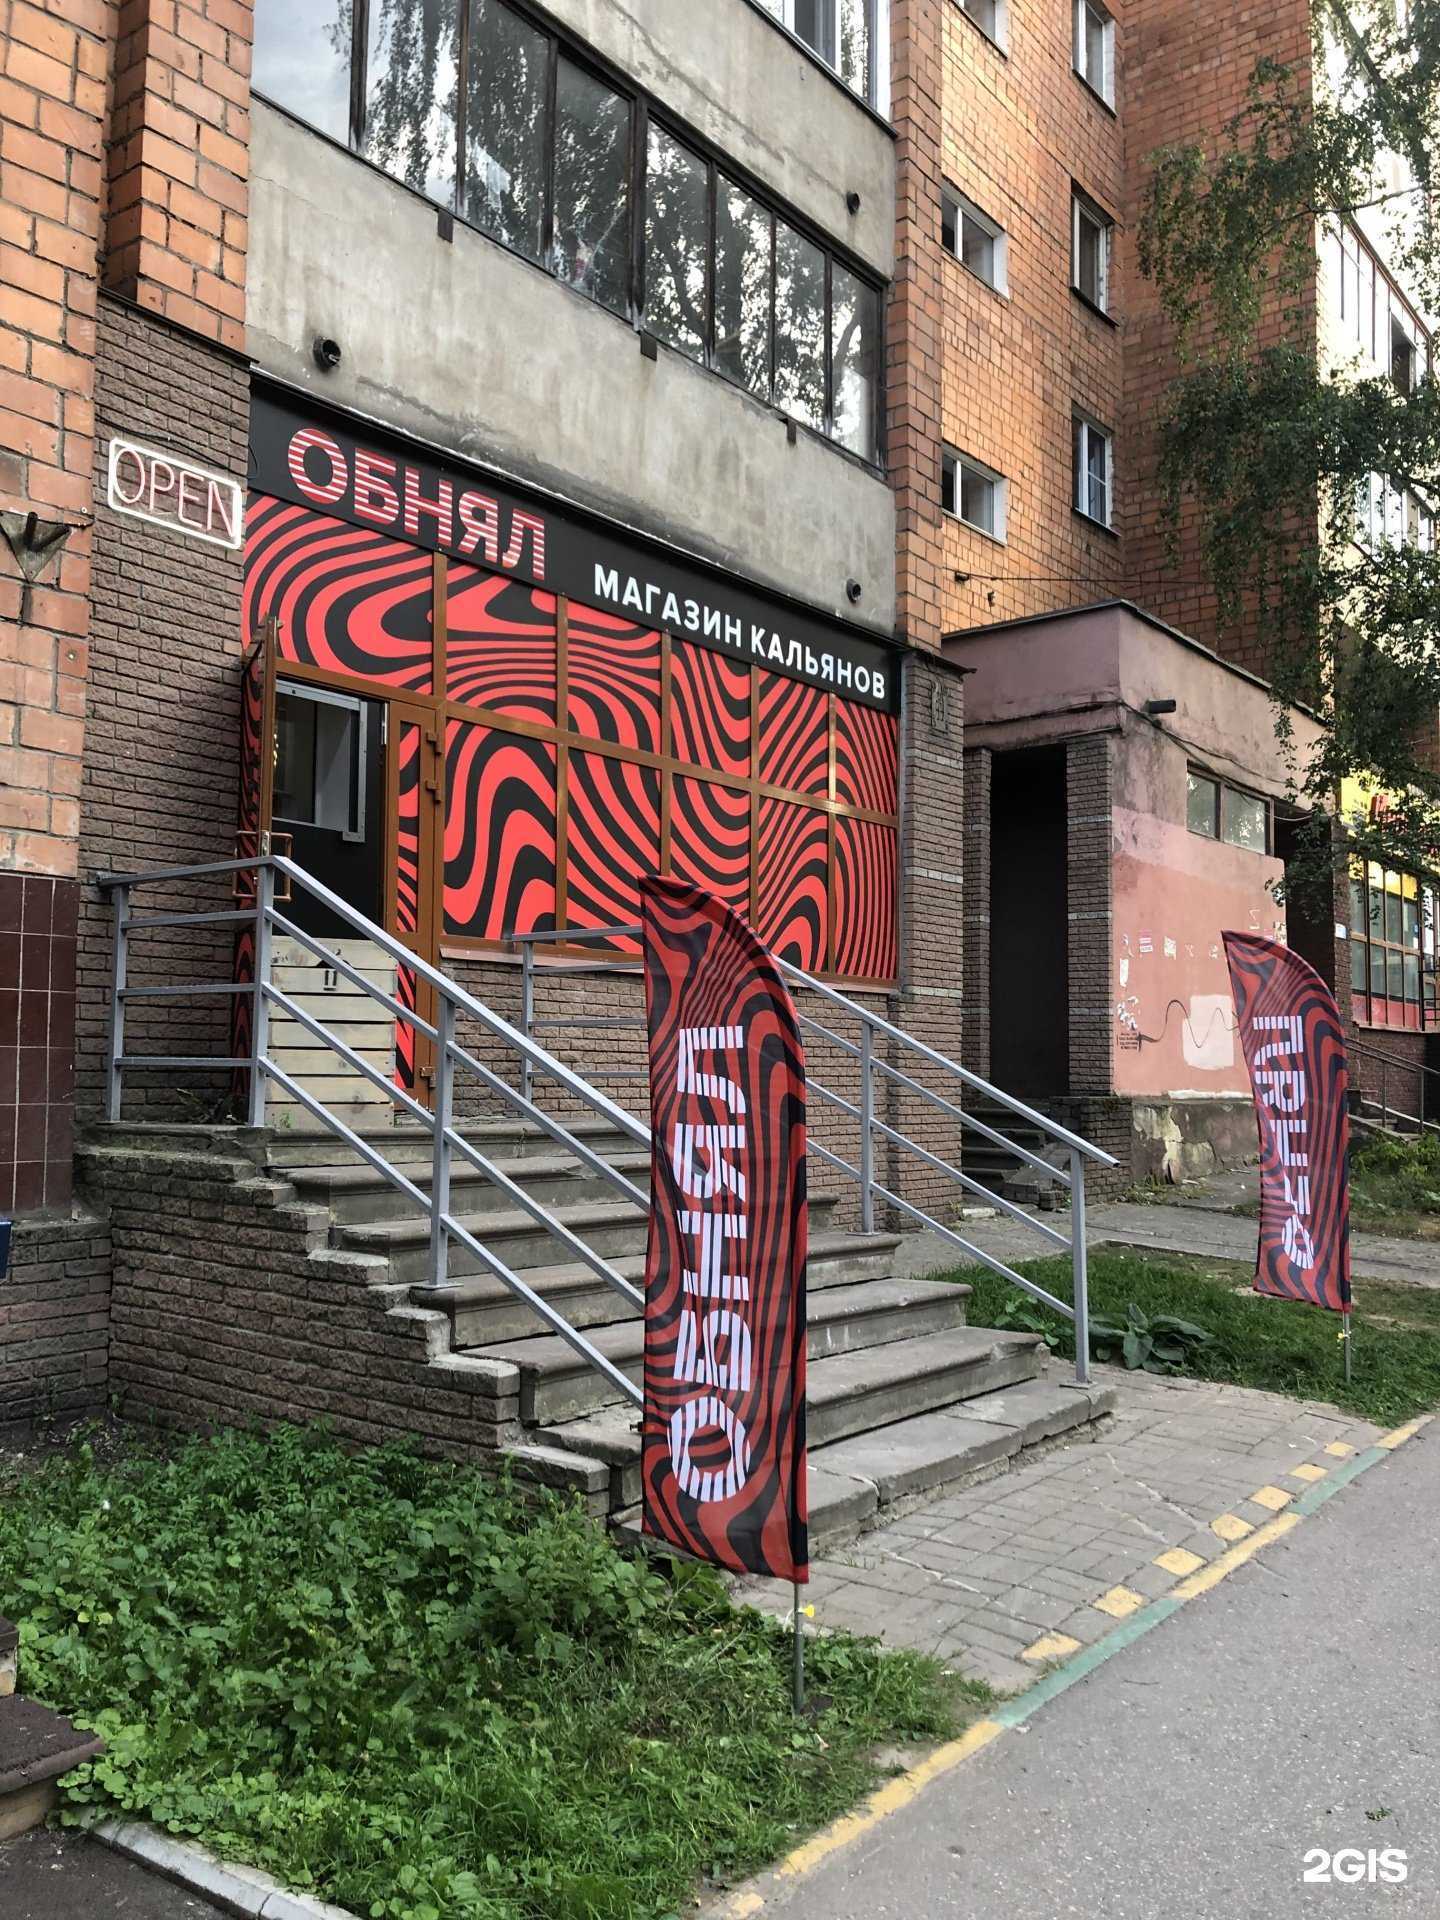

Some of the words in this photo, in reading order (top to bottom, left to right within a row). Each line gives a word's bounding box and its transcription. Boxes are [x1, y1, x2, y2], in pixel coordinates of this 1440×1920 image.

[113, 448, 239, 539] OPEN
[287, 427, 546, 581] ОБНЯЛ
[593, 563, 742, 648] МАГАЗИН
[750, 624, 886, 699] КАЛЬЯНОВ
[667, 1025, 752, 1503] ОБНЯЛ
